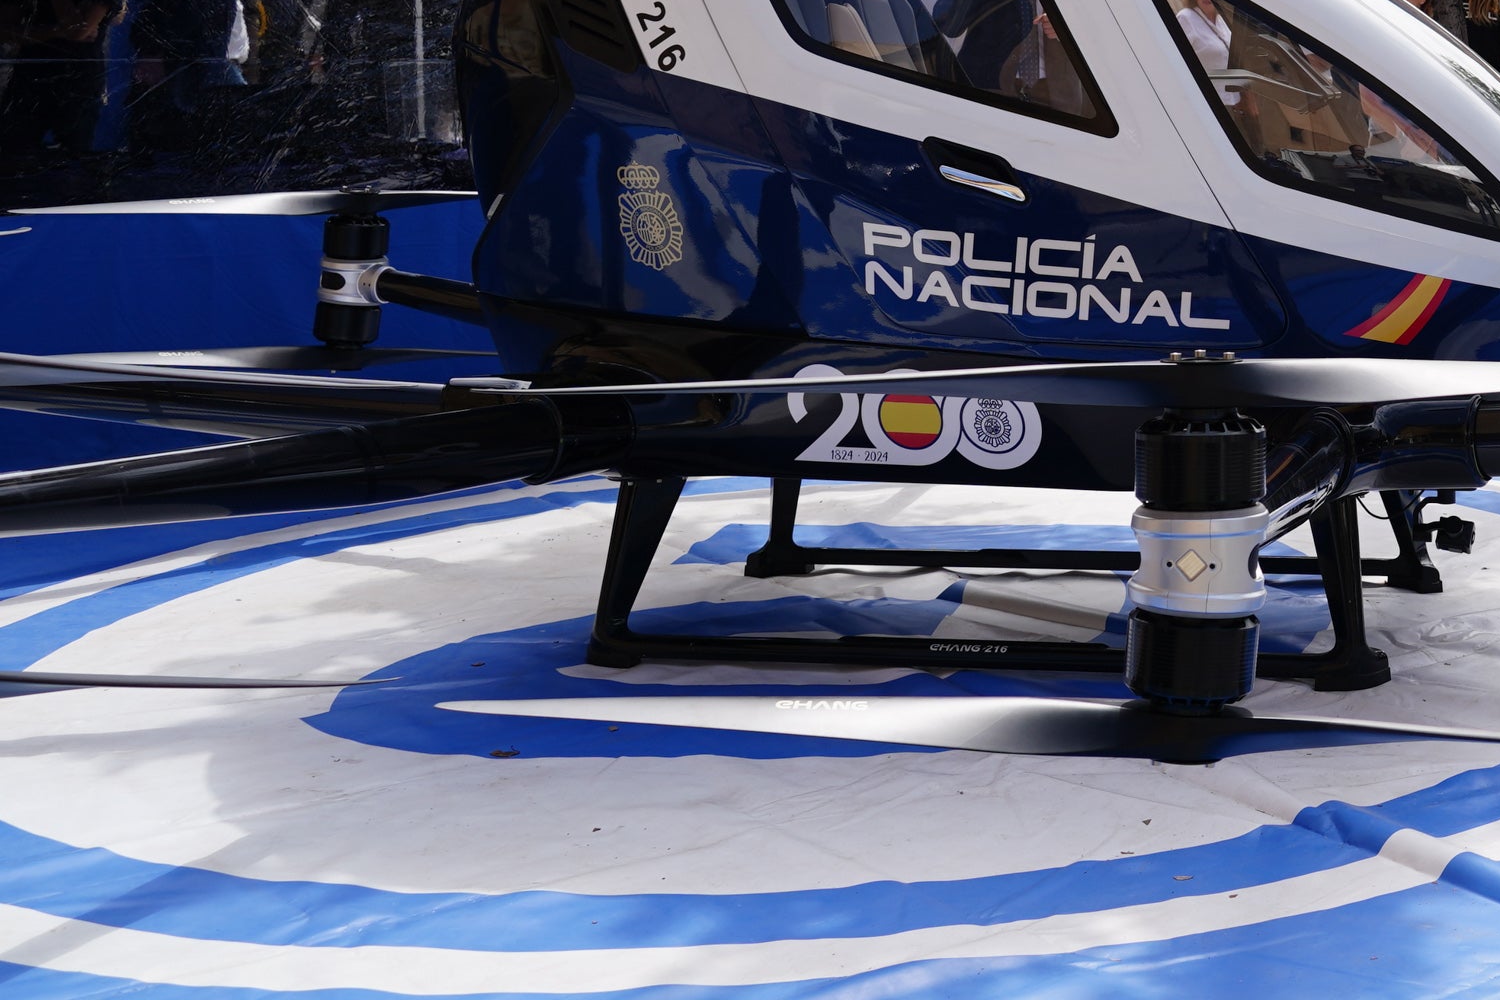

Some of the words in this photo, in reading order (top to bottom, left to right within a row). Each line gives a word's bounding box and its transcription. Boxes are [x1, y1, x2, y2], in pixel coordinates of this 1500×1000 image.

[636, 1, 686, 72] 216
[862, 222, 1143, 283] POLICÍA
[865, 260, 1230, 330] NACIONAL
[831, 449, 853, 461] 1824
[864, 450, 888, 462] 2024
